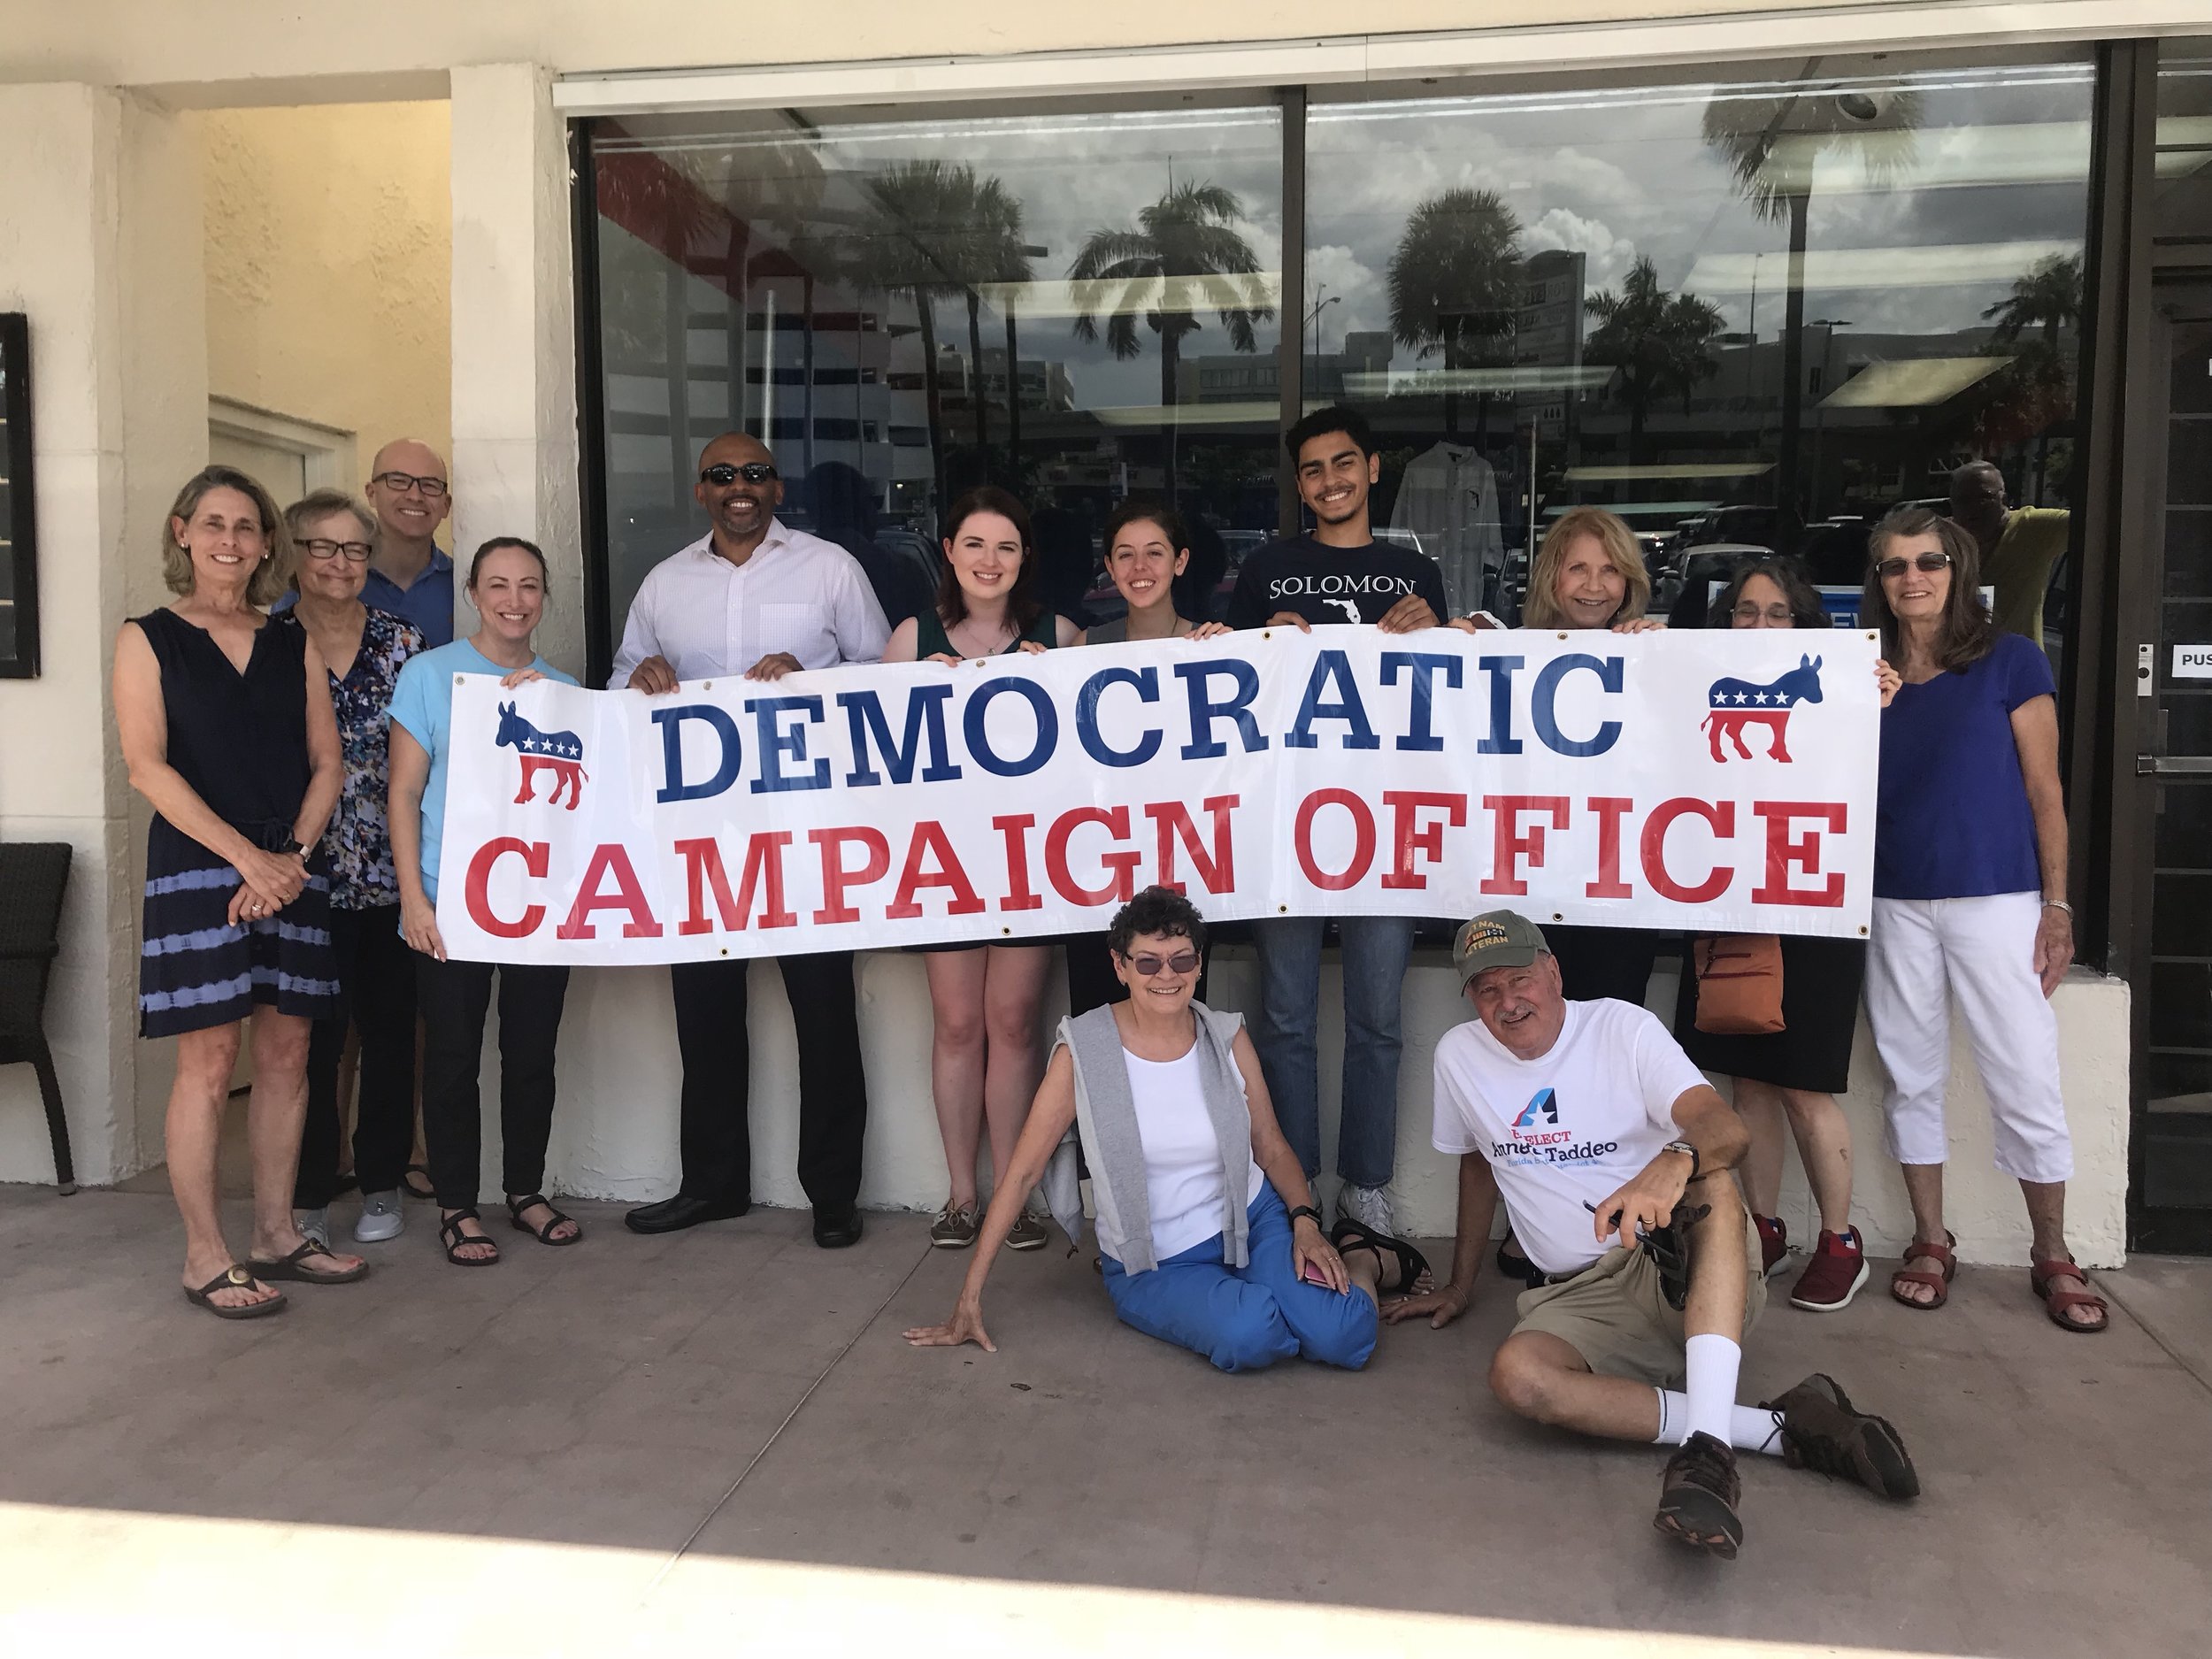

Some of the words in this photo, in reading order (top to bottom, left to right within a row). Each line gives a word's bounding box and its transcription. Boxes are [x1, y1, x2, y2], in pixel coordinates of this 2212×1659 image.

[1270, 575, 1417, 599] SOLOMON
[651, 649, 1625, 803] DEMOCRATIC
[465, 794, 1240, 939] CAMPAIGN
[1294, 787, 1847, 907] OFFICE
[1545, 1141, 1617, 1162] Taddeo
